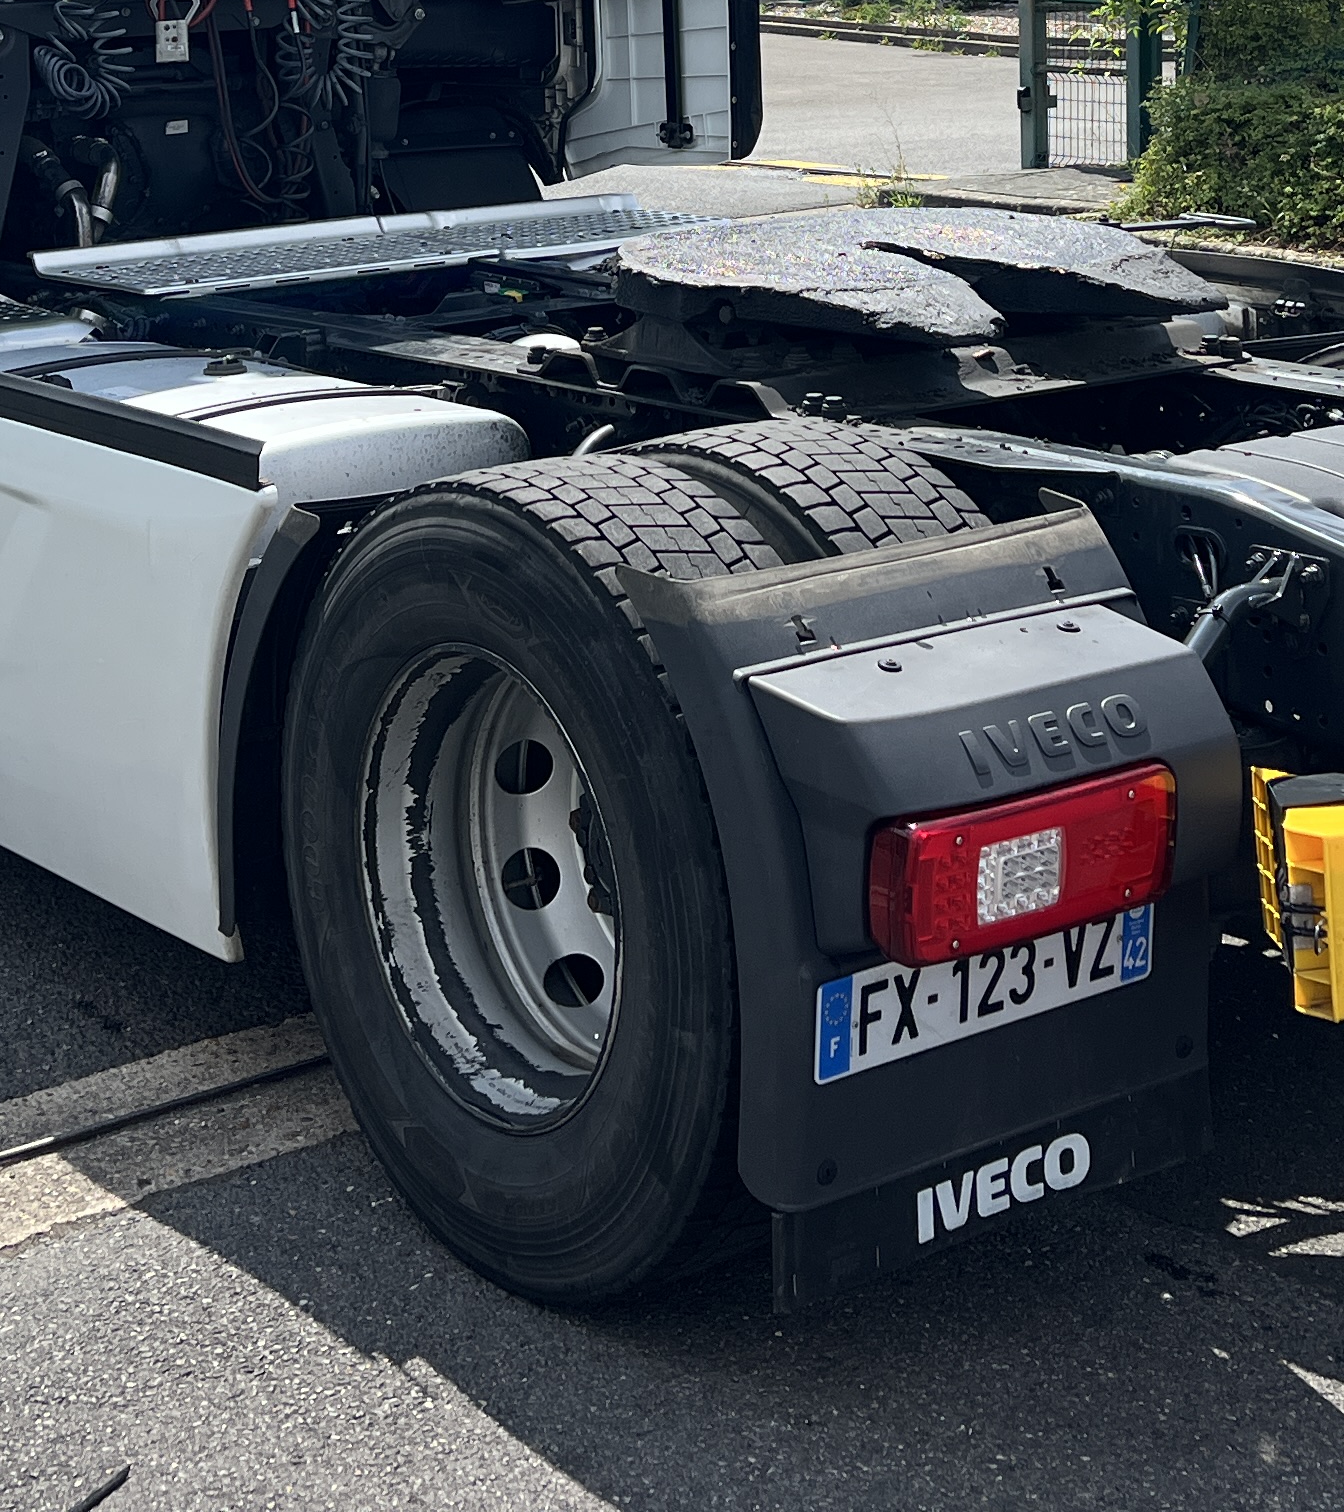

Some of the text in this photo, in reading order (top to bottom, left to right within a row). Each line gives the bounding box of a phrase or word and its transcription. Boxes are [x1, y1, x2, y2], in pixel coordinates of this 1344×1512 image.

[959, 693, 1149, 776] IVECO
[858, 913, 1117, 1057] FX-123-VZ
[1123, 936, 1147, 970] 42
[829, 1036, 841, 1058] F
[917, 1132, 1091, 1245] IVECO
